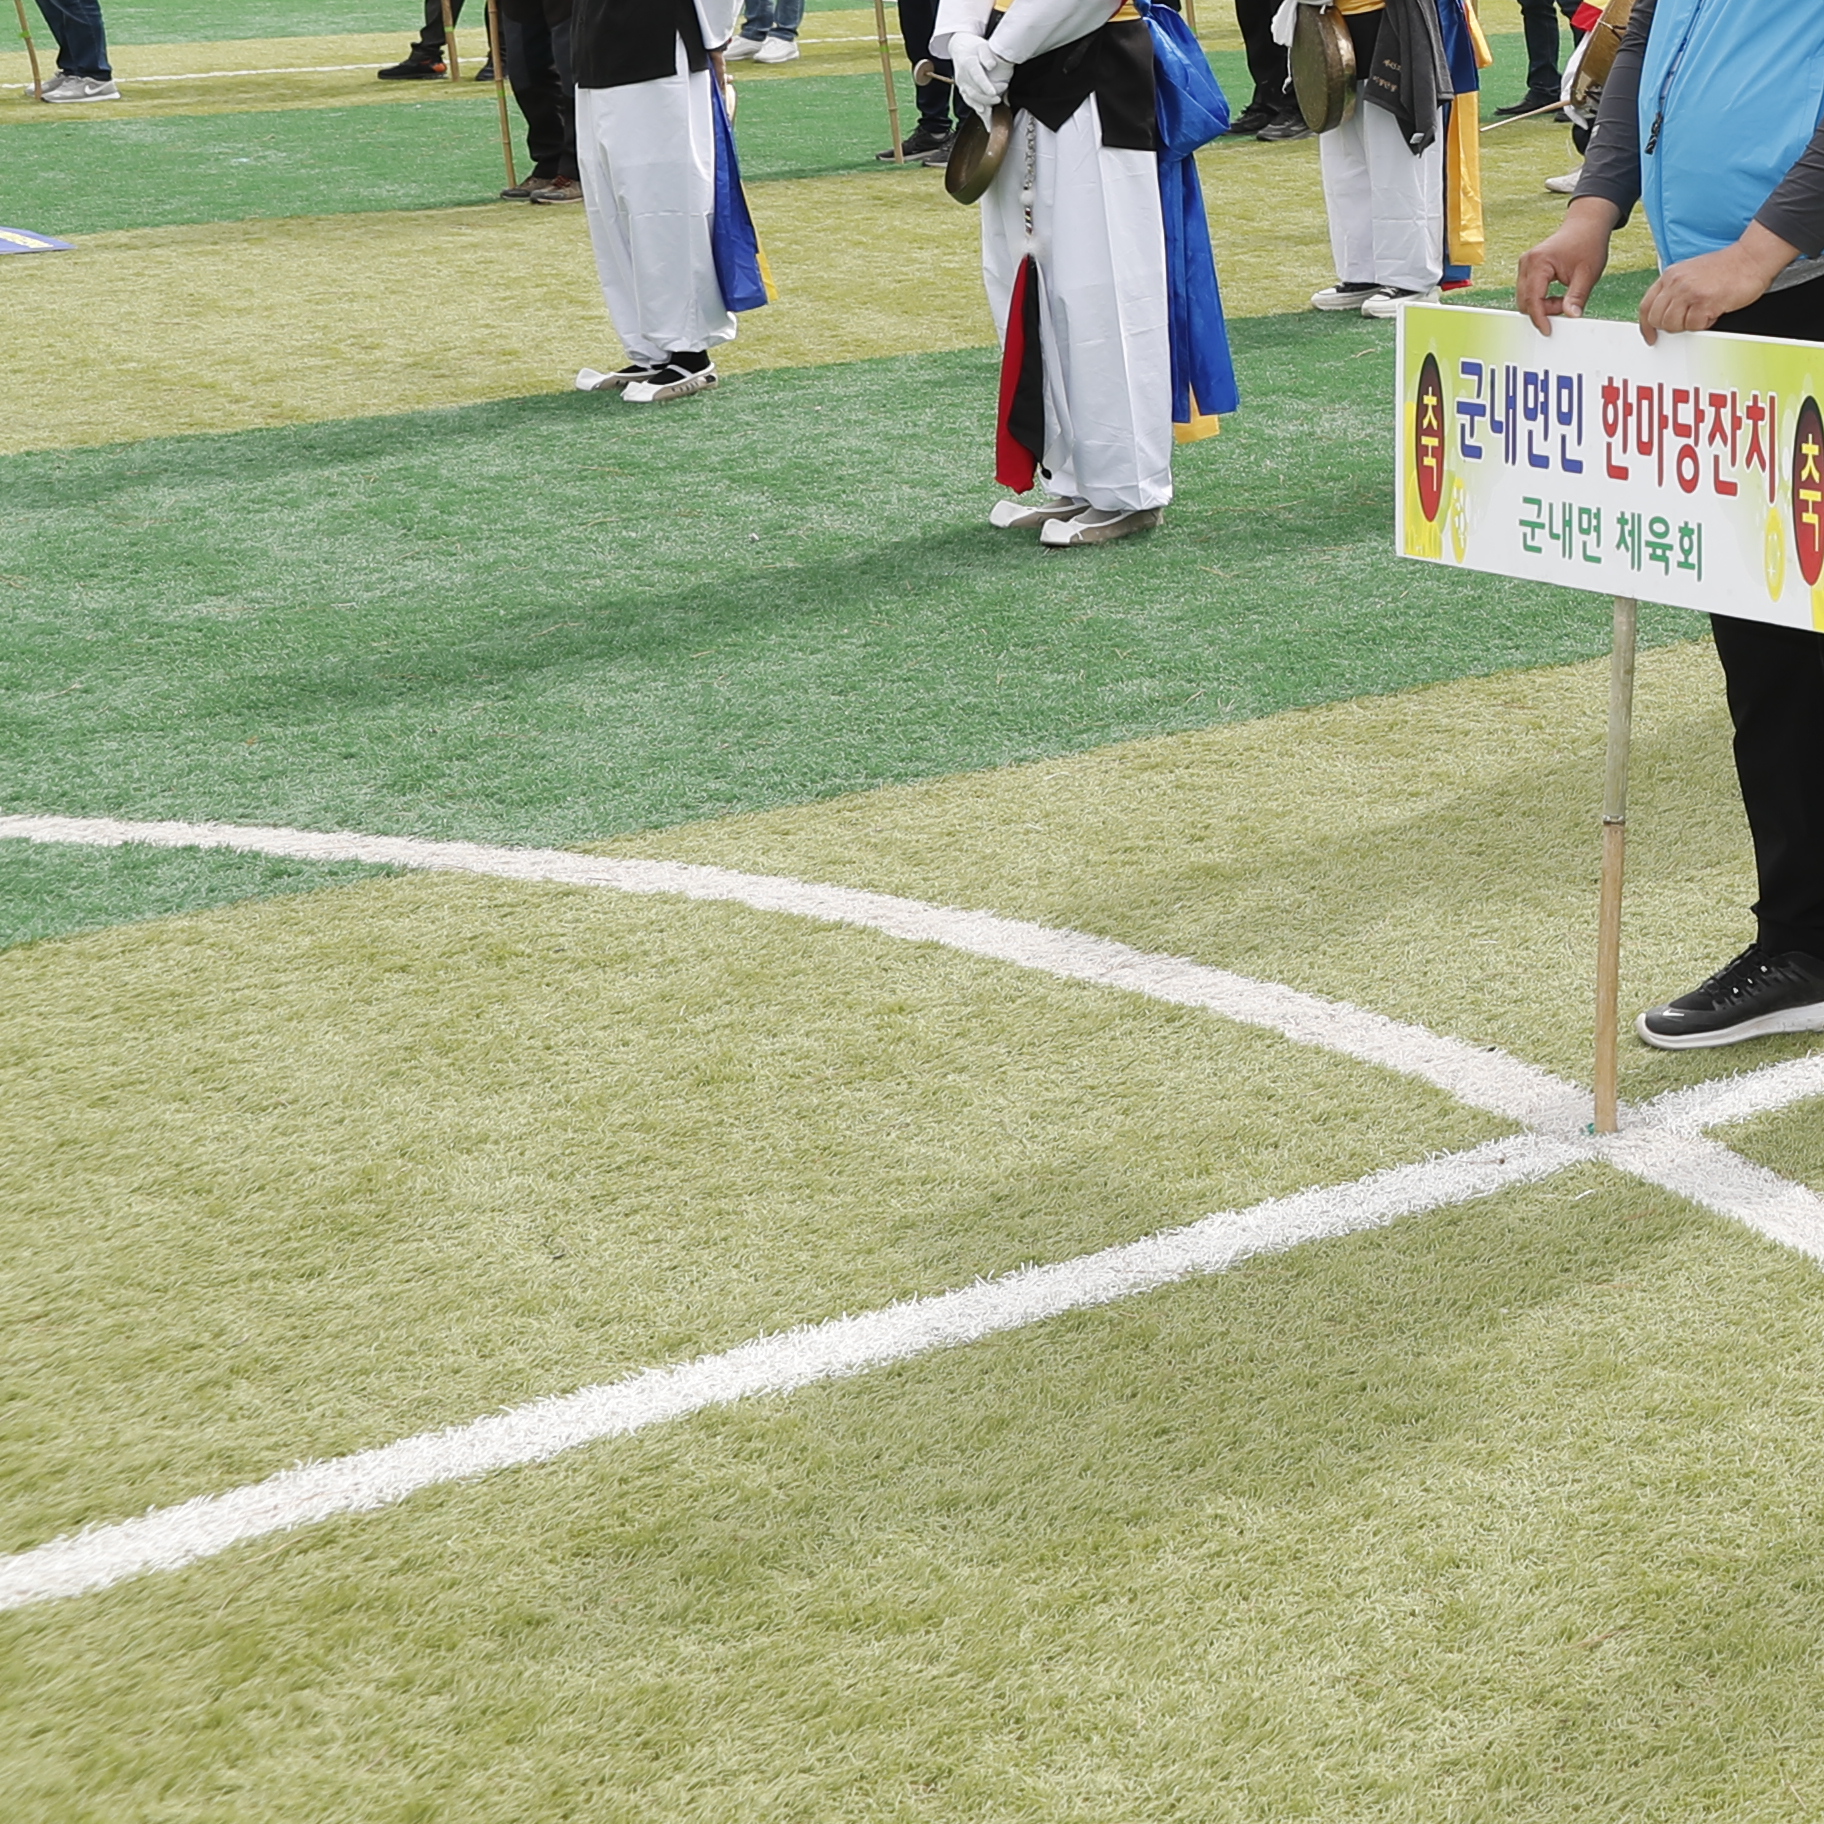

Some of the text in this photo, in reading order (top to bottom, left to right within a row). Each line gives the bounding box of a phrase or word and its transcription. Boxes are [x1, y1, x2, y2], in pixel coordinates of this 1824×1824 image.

[1421, 386, 1439, 493] 축
[1456, 359, 1778, 505] 군내면민 한마당잔치
[1518, 496, 1704, 582] 군내면 체육회
[1798, 433, 1822, 553] 축
